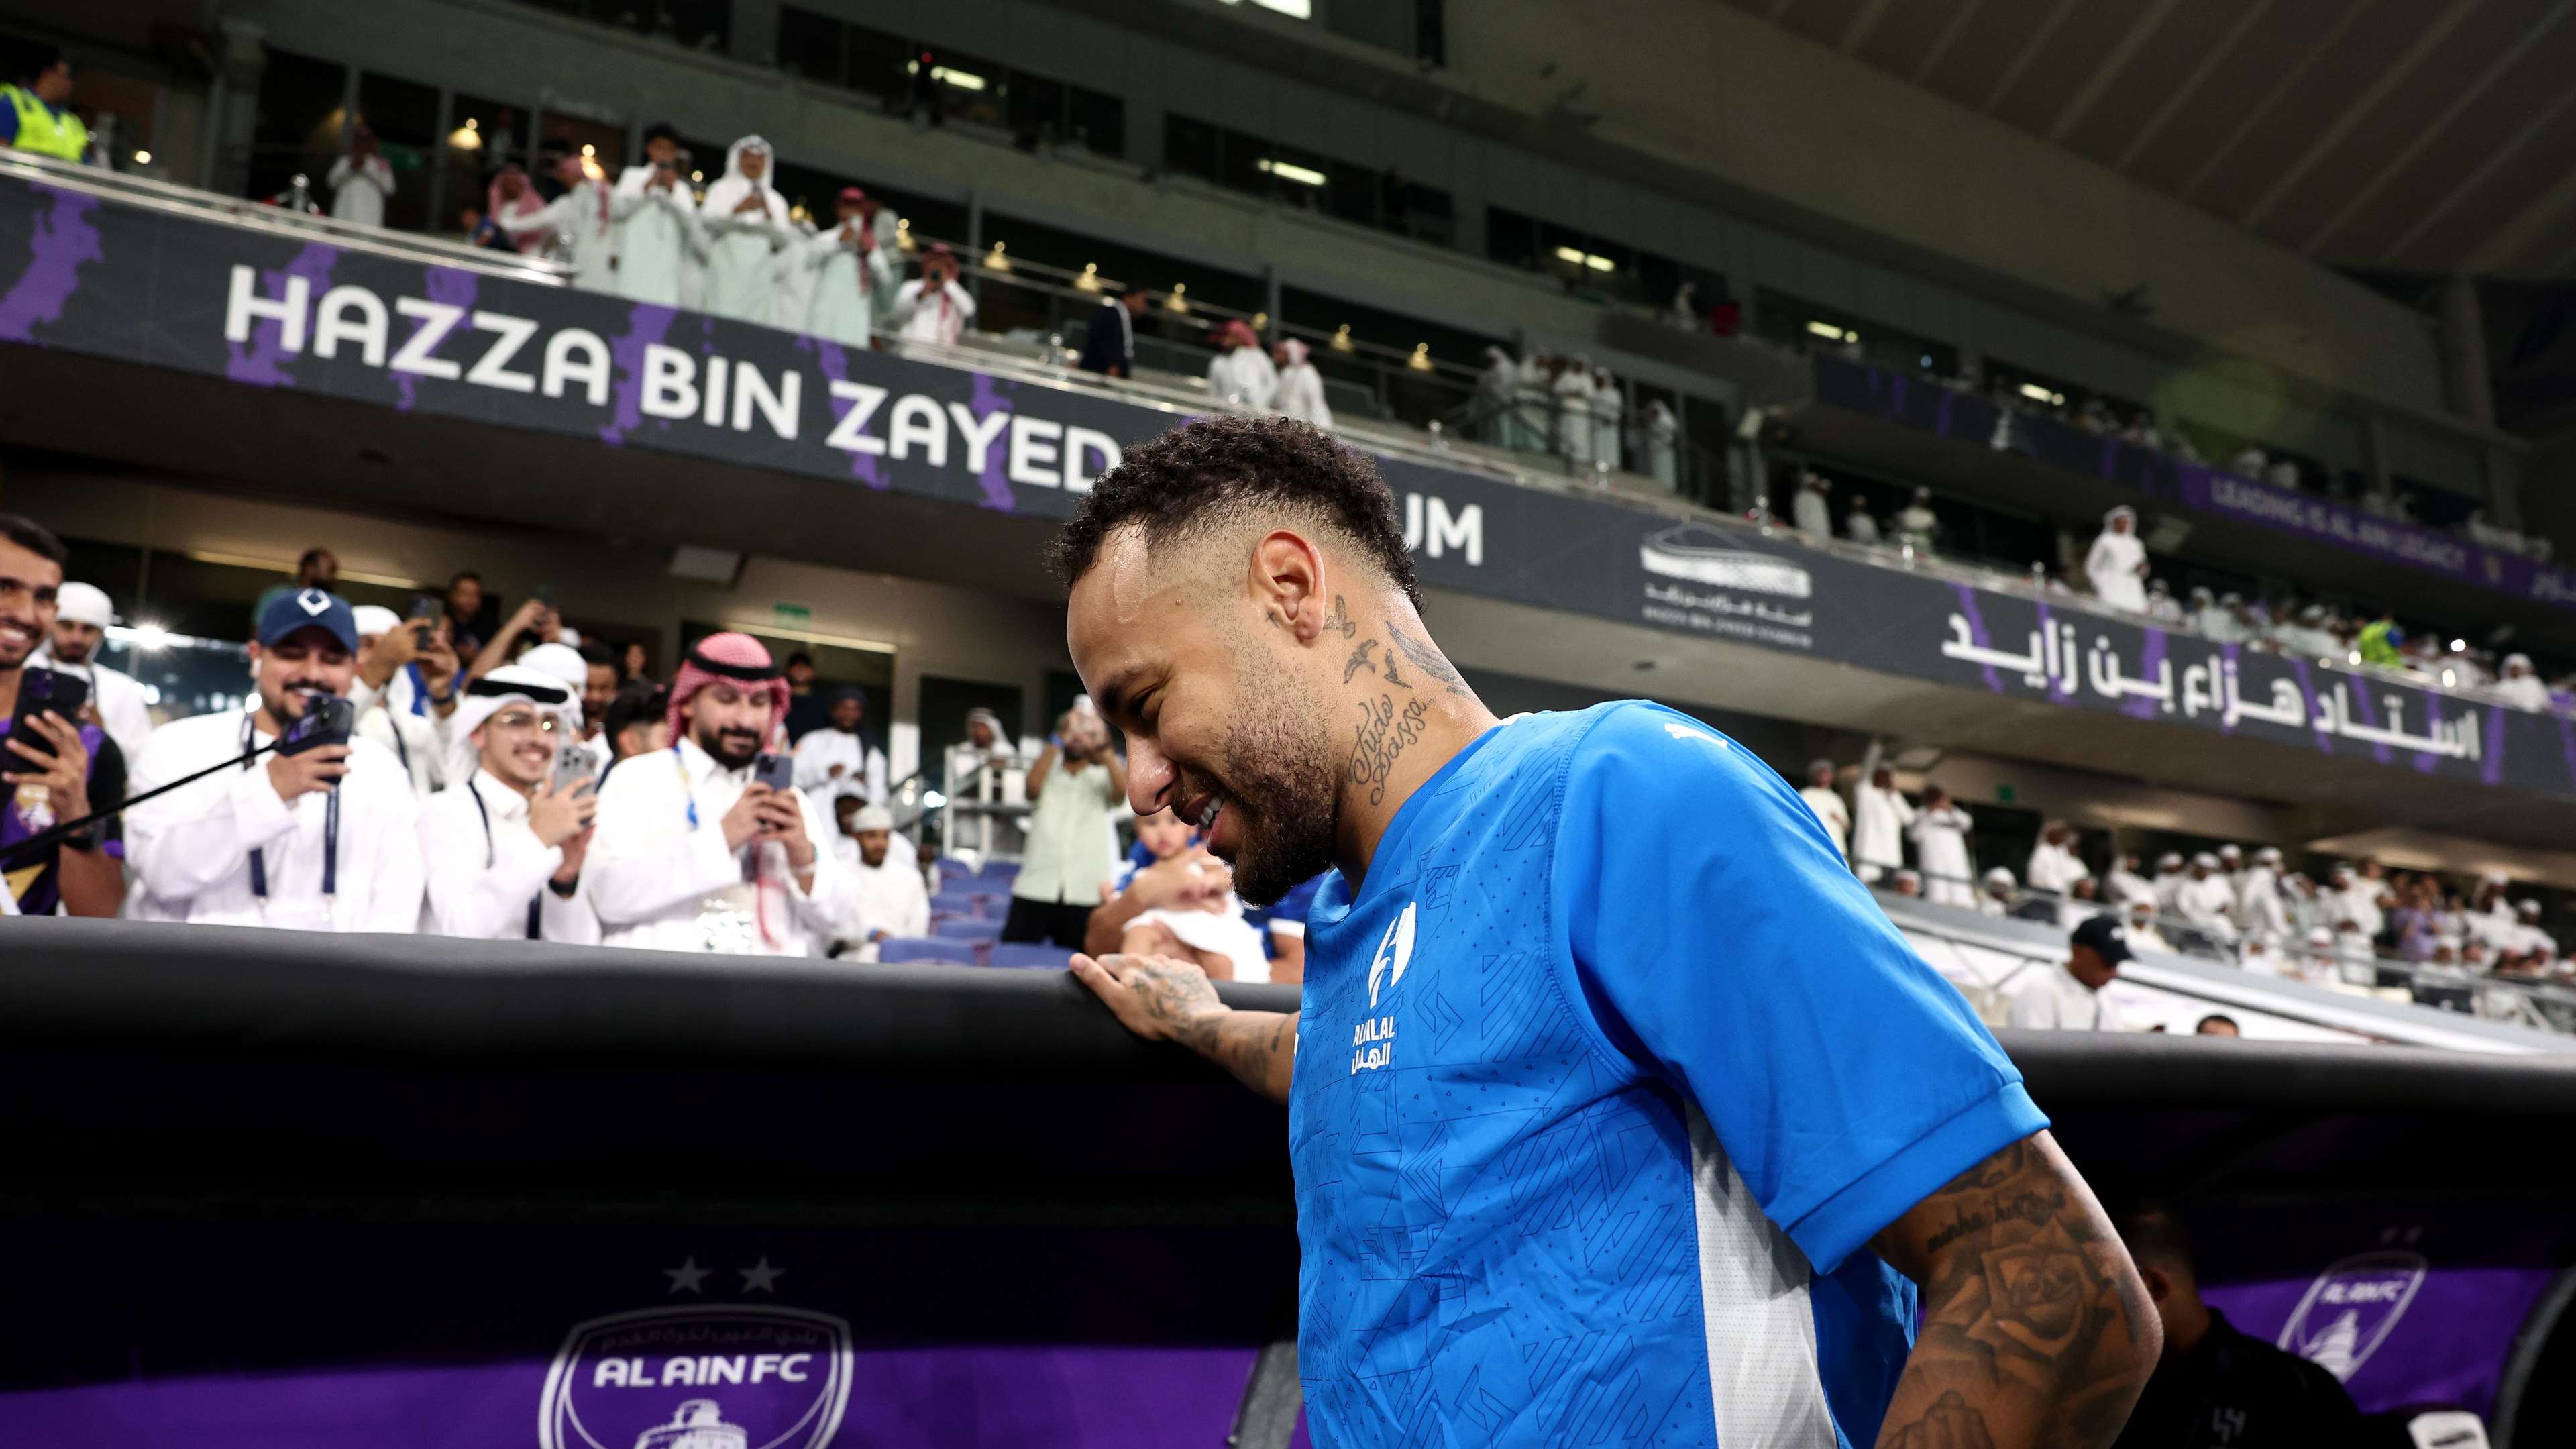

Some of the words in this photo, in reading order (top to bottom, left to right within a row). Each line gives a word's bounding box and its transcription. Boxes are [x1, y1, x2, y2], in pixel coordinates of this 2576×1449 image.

[224, 264, 611, 407] HAZZA
[640, 343, 802, 440] BIN
[825, 378, 1122, 494] ZAYED
[1941, 612, 2078, 695] زايد
[2088, 635, 2176, 714] بن
[2182, 653, 2306, 727] هزاع
[1349, 694, 1393, 784] Tudo
[2312, 681, 2481, 761] استاد
[594, 1356, 655, 1387] AL
[661, 1354, 747, 1387] AIN
[749, 1353, 812, 1384] FC
